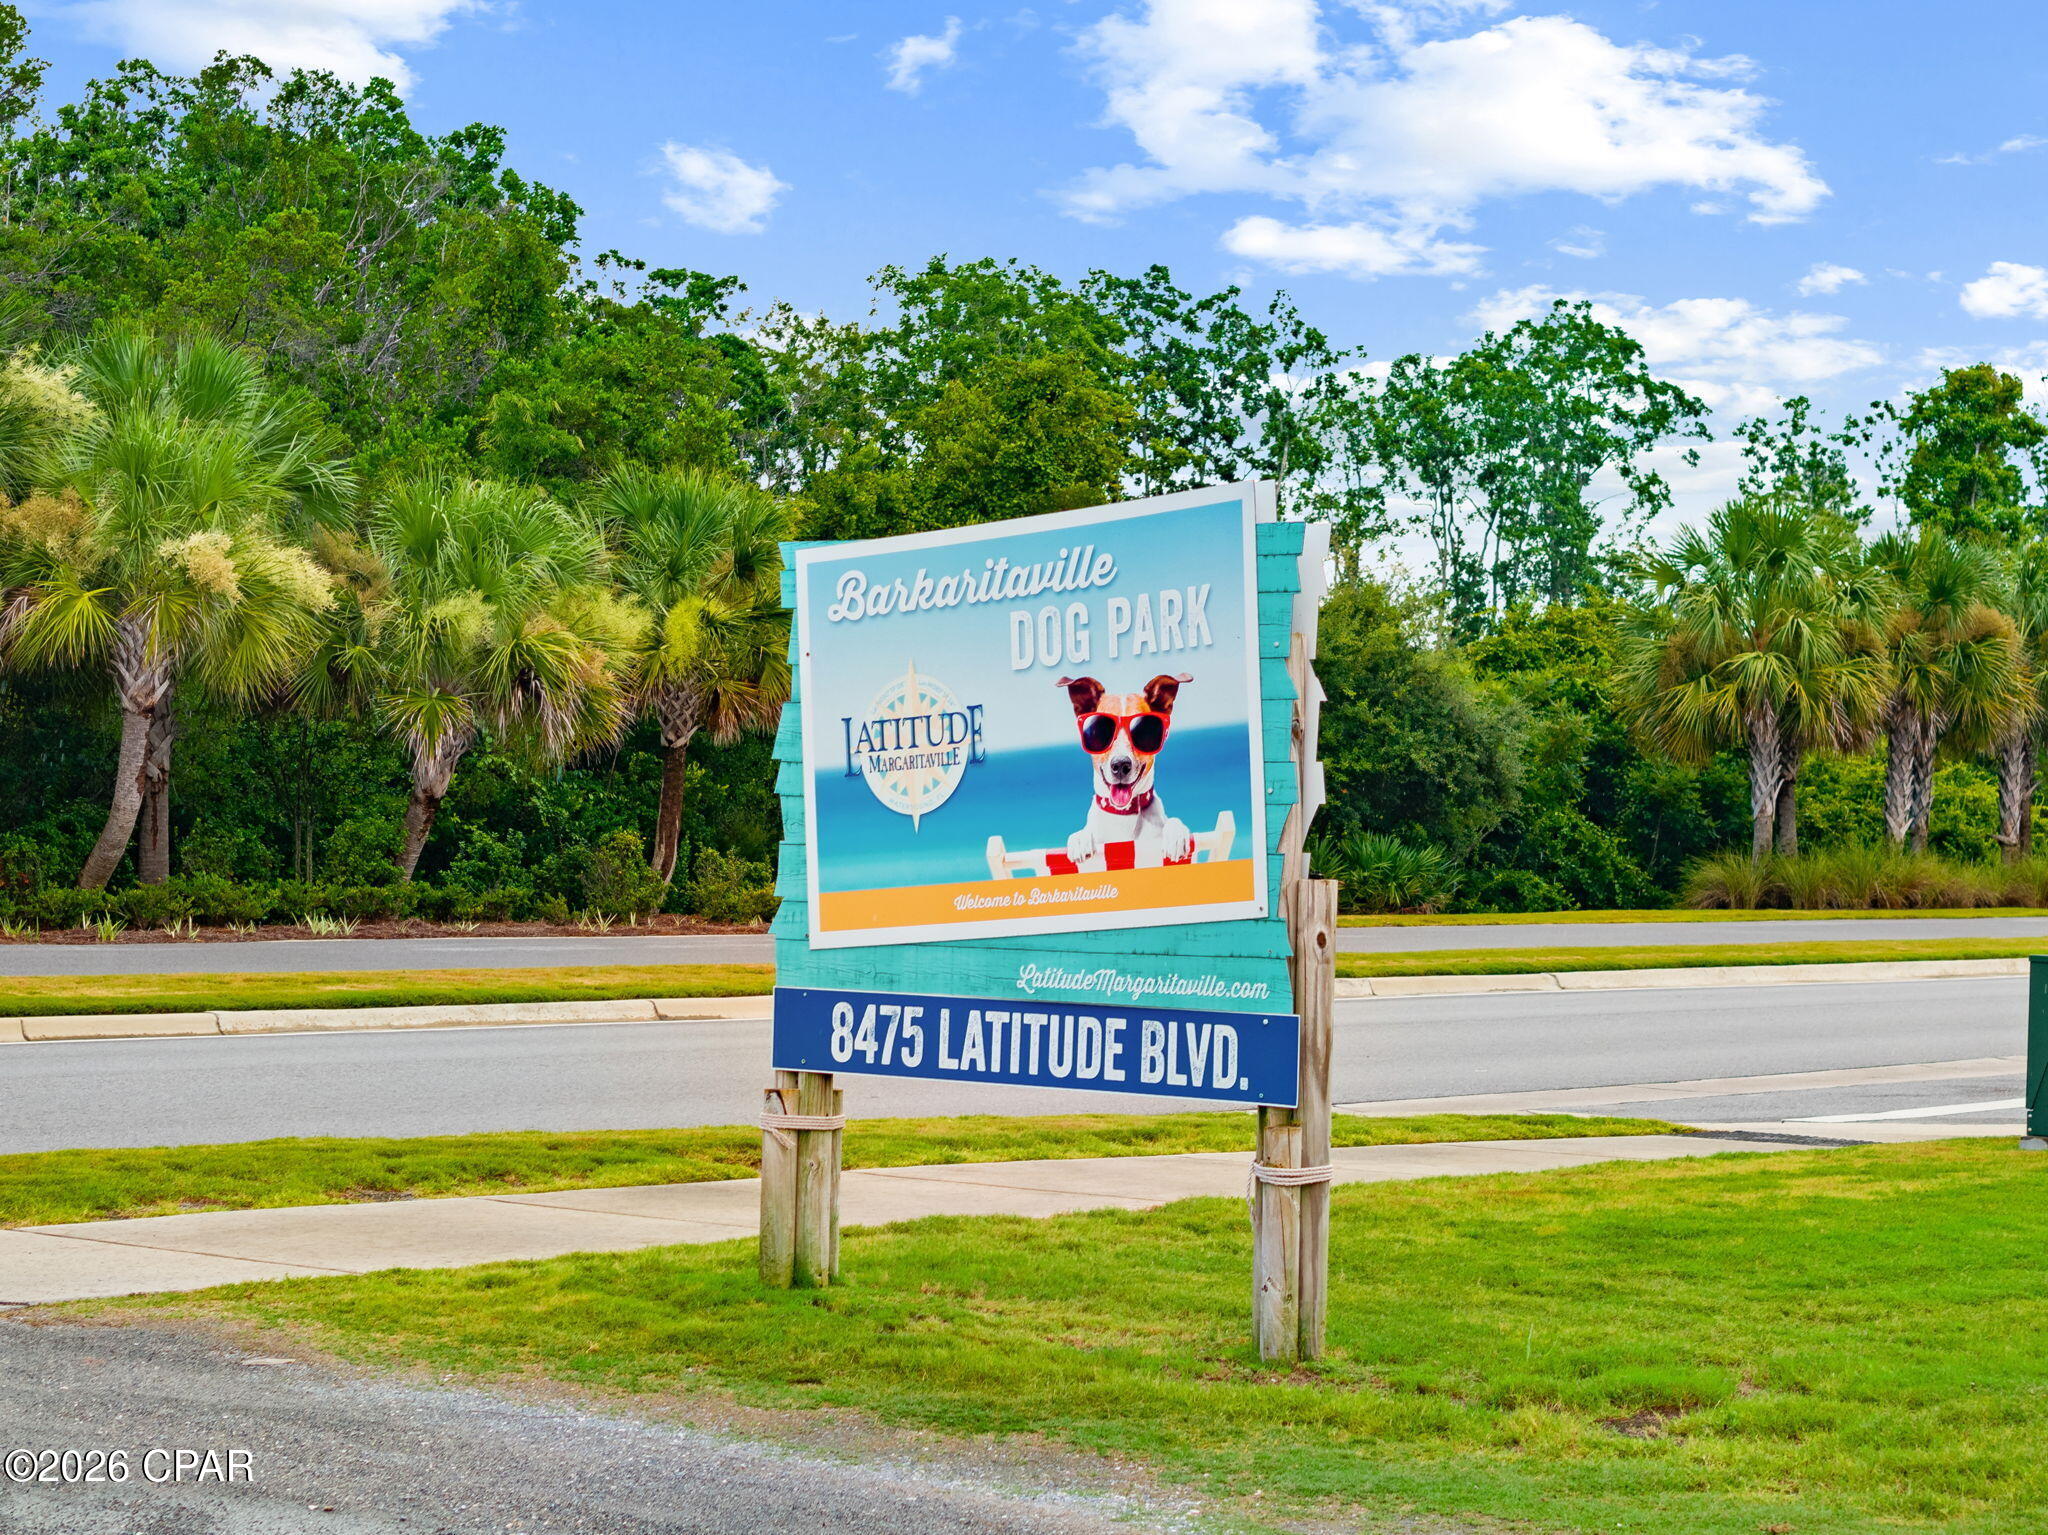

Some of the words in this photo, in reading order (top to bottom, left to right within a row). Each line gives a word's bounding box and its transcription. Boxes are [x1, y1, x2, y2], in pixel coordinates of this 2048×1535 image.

[828, 544, 1118, 622] Barkaritaville
[1010, 602, 1090, 671] DOG
[1107, 584, 1213, 658] PARK
[841, 704, 986, 777] LATITUDE
[869, 747, 960, 773] MARGARITAVILLE
[953, 893, 1011, 910] Welcome
[1010, 892, 1026, 906] to
[1028, 884, 1118, 905] Barkaritaville
[1016, 963, 1270, 1000] LatitudeMargaritaville.com
[830, 1001, 924, 1068] 8475
[938, 1007, 1126, 1081] LATITUDE
[1140, 1019, 1249, 1091] BLVD.
